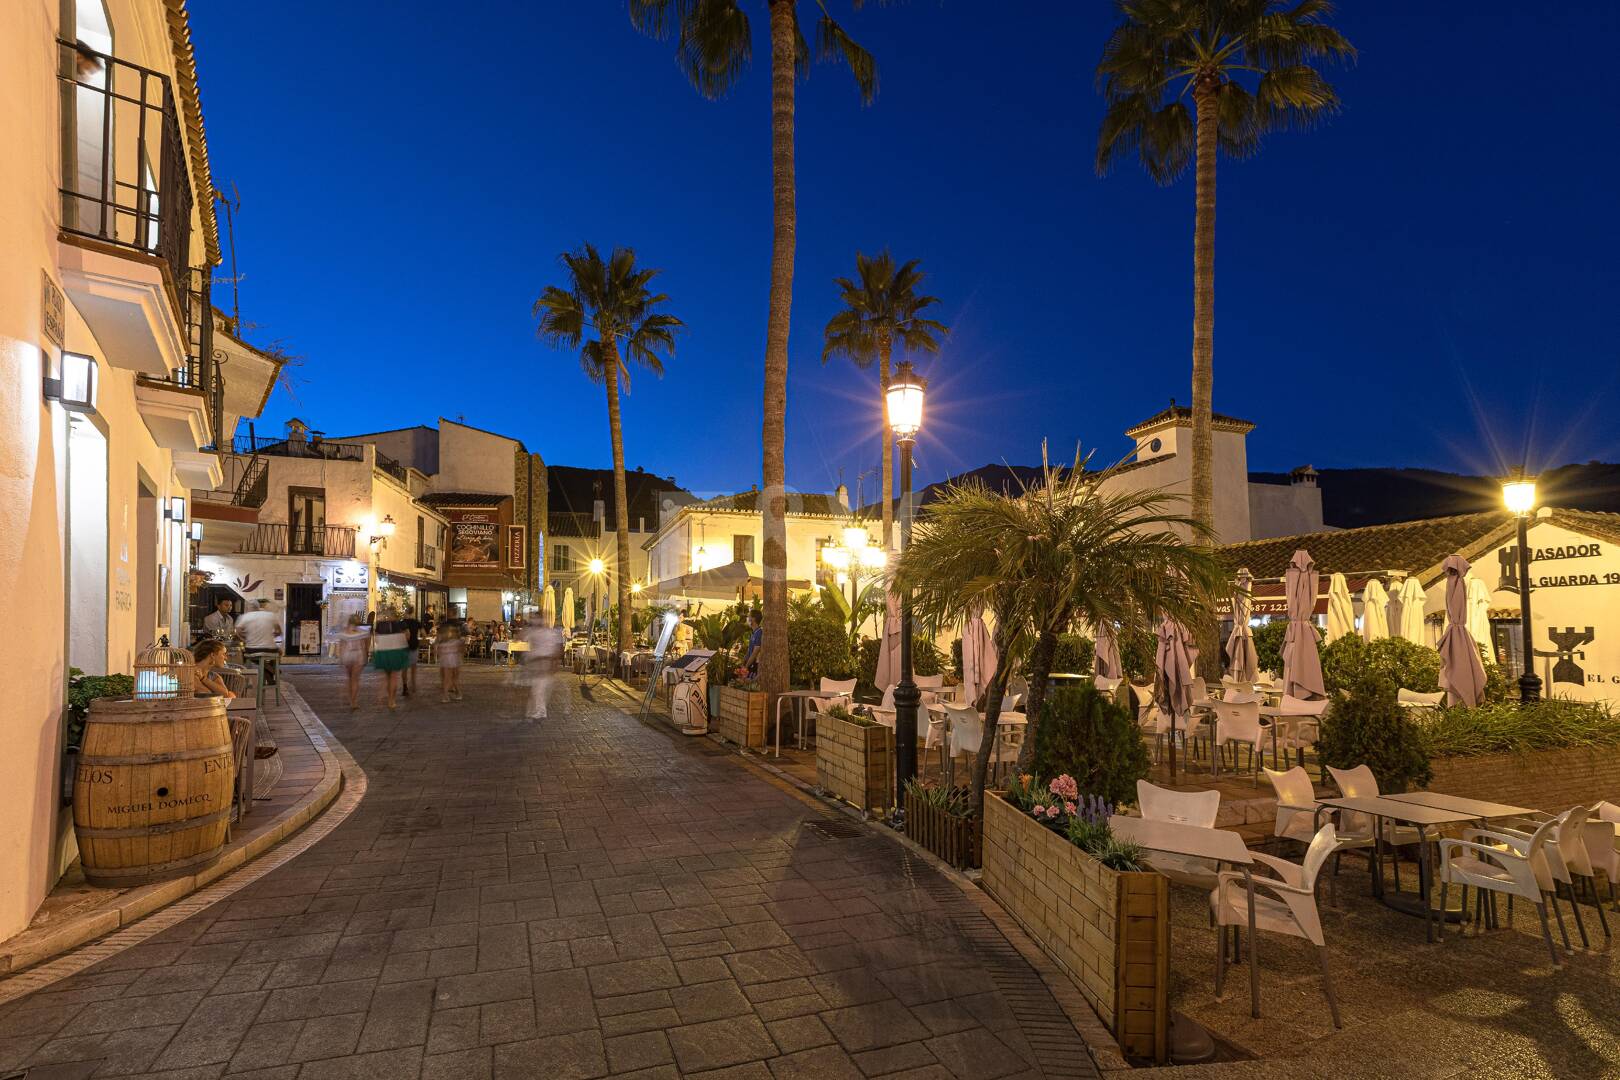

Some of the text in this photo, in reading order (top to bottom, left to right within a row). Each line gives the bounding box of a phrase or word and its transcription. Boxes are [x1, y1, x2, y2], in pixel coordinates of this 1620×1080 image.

[1535, 543, 1601, 560] ASADOR
[1540, 574, 1598, 587] GUARDA
[1587, 674, 1620, 684] EL G
[107, 793, 211, 814] MIGUEL DOMECQ
